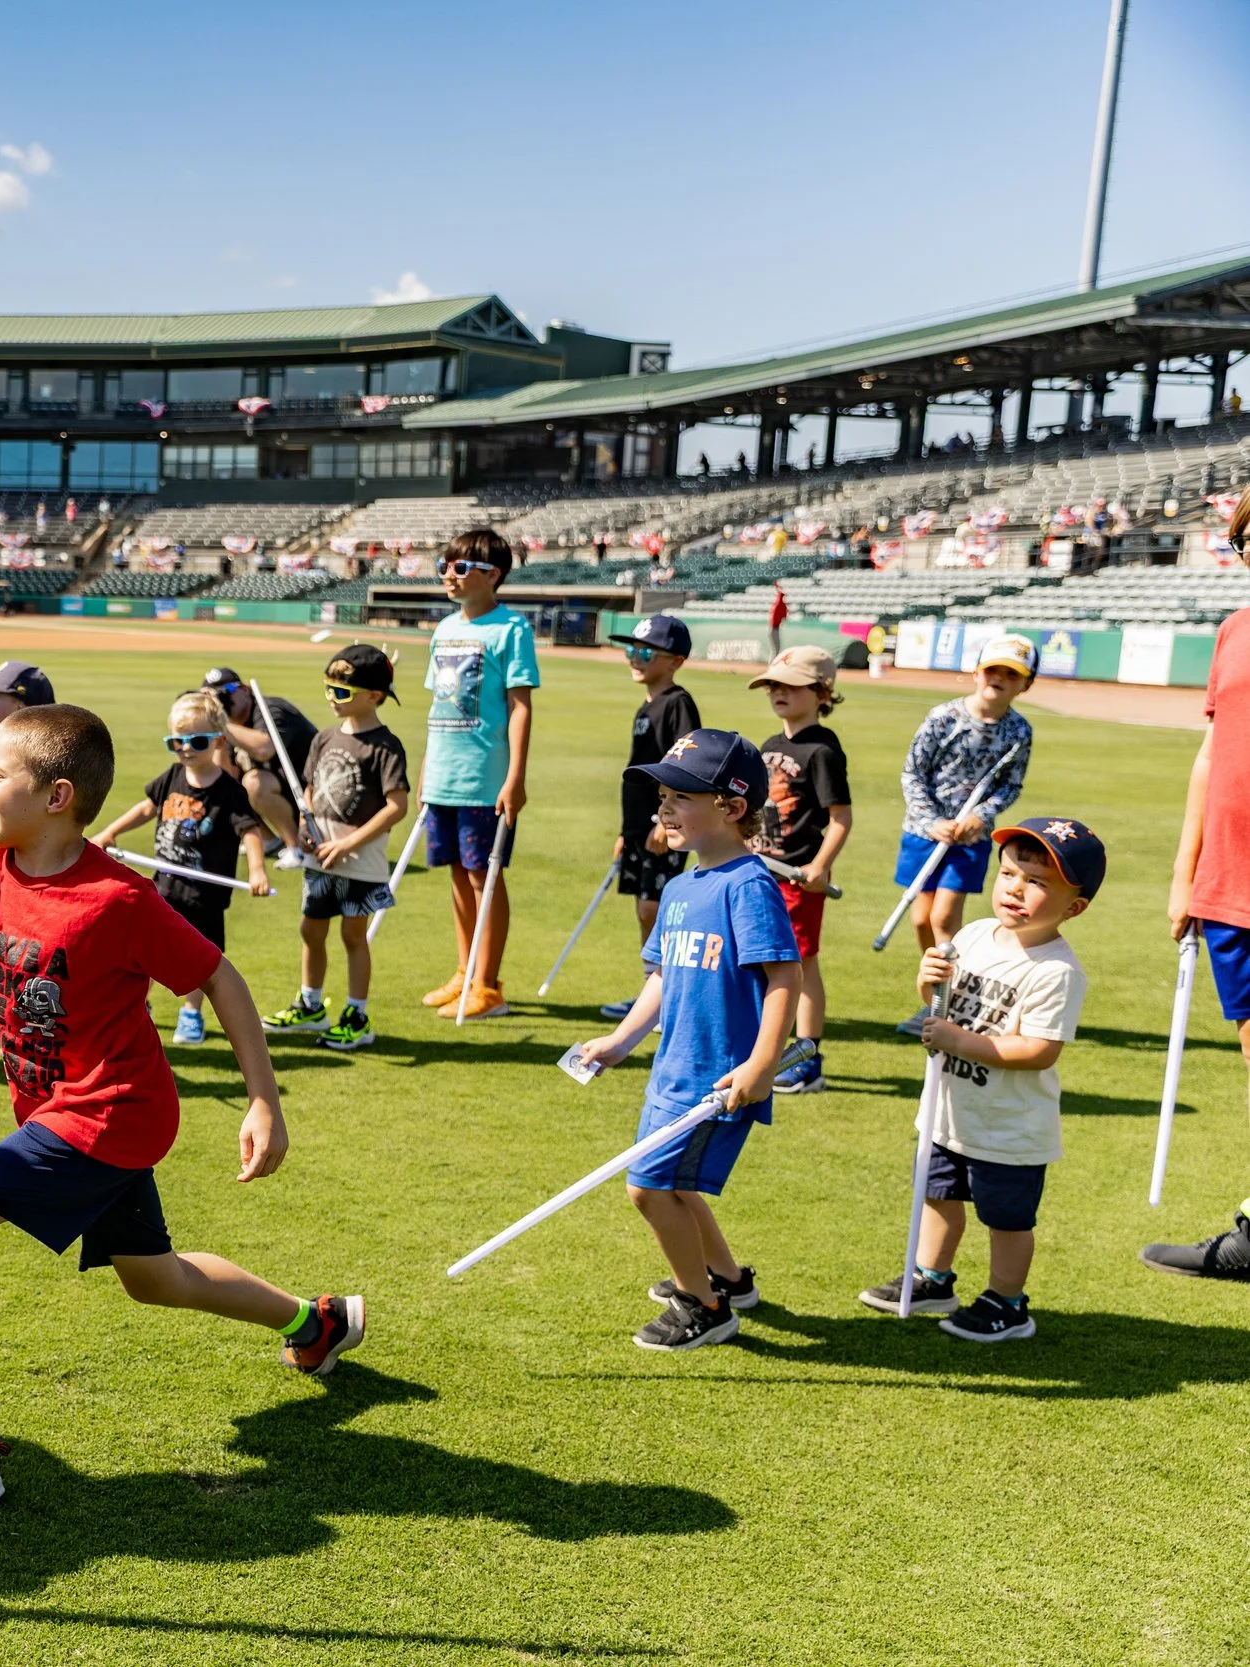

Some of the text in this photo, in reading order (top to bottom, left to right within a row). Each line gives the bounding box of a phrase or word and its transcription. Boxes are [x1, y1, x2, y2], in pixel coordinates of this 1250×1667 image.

[666, 902, 688, 925] BIG
[46, 948, 69, 980] A
[957, 970, 1016, 1008] USINS
[22, 1038, 66, 1057] NOT
